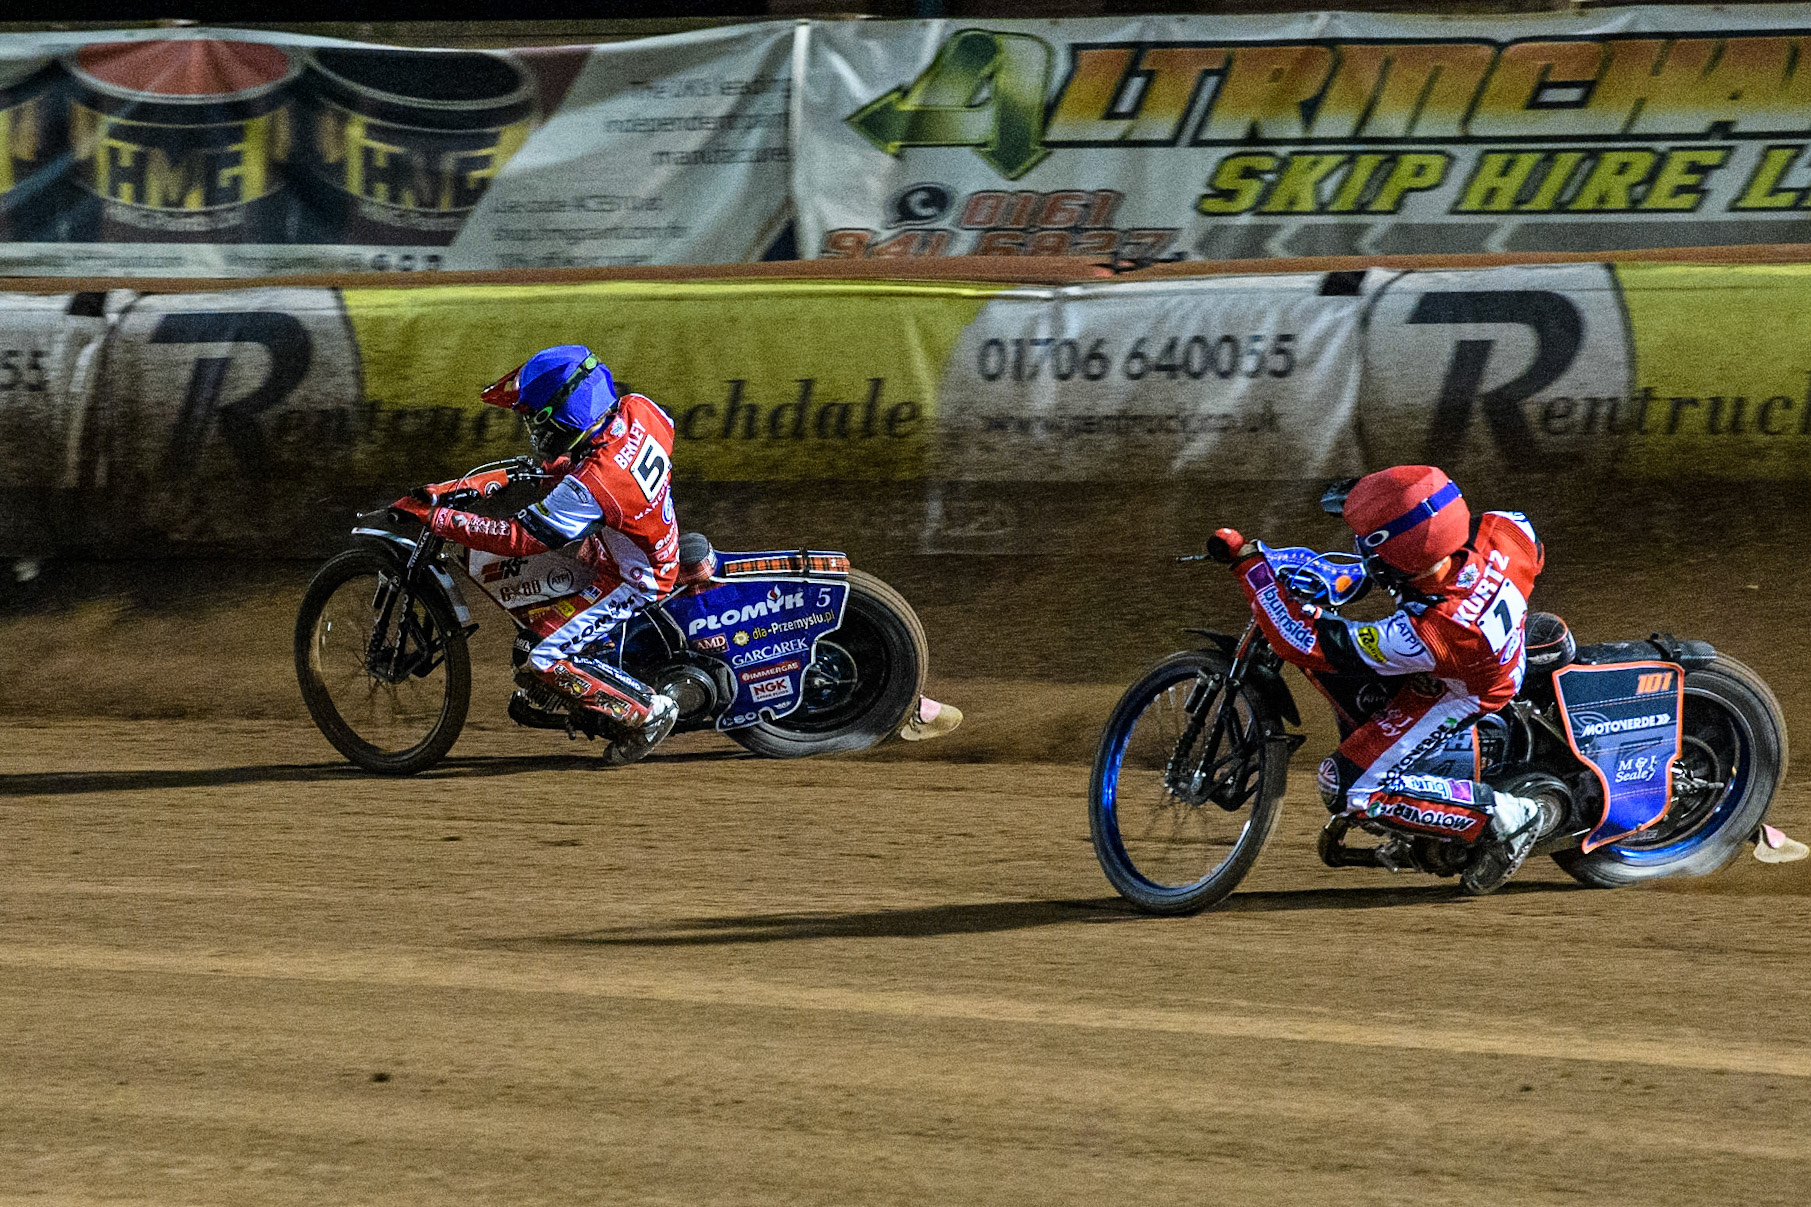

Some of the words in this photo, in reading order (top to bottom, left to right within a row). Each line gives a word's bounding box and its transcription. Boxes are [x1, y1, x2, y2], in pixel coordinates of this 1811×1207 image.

[1197, 149, 1456, 215] SKIP
[1449, 145, 1737, 215] HIRE
[1726, 143, 1811, 213] L
[956, 188, 1125, 230] 0161
[976, 335, 1112, 382] 01706
[1124, 332, 1296, 381] 640055
[660, 377, 922, 440] chdale
[613, 417, 647, 471] BEWLEY
[637, 444, 665, 493] 5
[816, 587, 832, 608] 5
[1453, 549, 1510, 629] KURTZ
[1263, 586, 1315, 648] burnside
[1493, 598, 1513, 637] 1
[732, 637, 808, 667] GARCAREK
[753, 679, 788, 696] NGK
[1635, 671, 1674, 696] 101
[1581, 715, 1657, 737] MOTOVERDE
[1618, 758, 1634, 772] M
